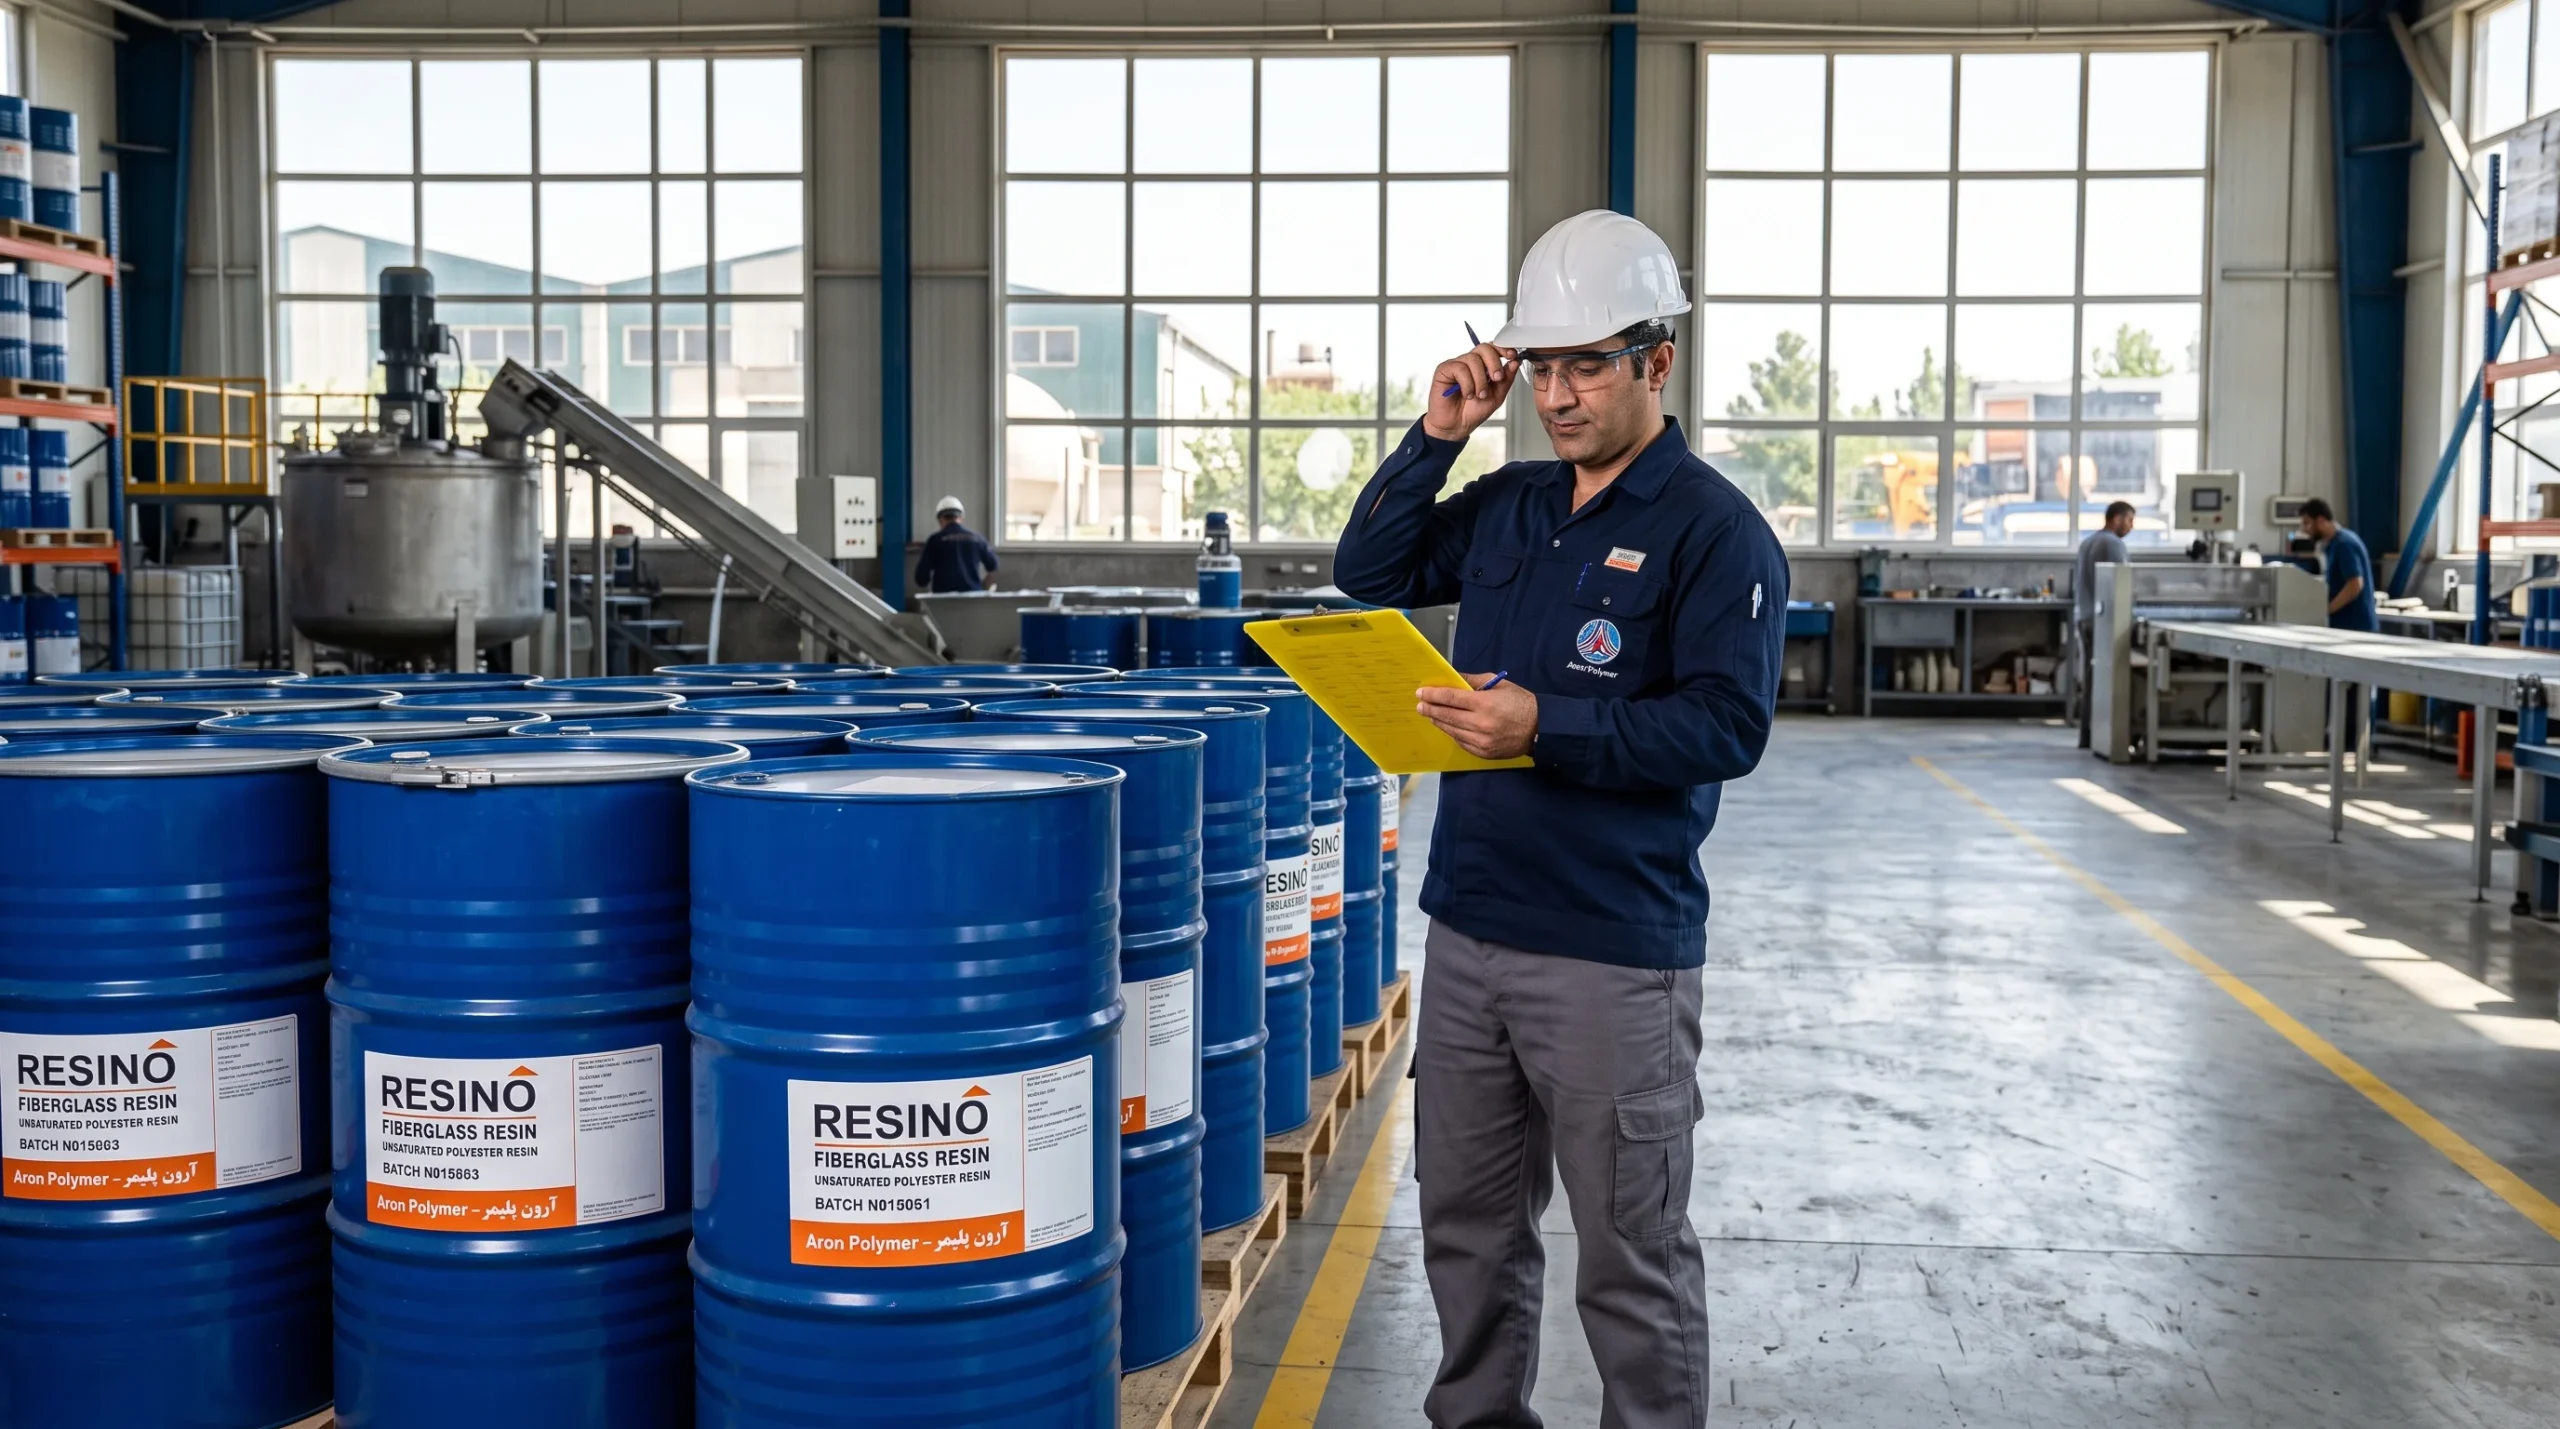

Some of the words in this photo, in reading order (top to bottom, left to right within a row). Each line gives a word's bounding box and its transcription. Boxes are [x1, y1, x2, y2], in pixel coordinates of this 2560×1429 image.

[1311, 834, 1340, 856] SINO
[1266, 868, 1308, 893] ESINO
[19, 1096, 117, 1112] FIBERGLASS
[124, 1094, 177, 1111] RESIN
[19, 1118, 83, 1129] UNSATURATED
[85, 1117, 143, 1129] POLYESTER
[147, 1116, 179, 1126] RESIN
[382, 1119, 478, 1140] FIBERGLASS
[484, 1124, 537, 1139] RESIN
[19, 1138, 59, 1151] BATCH
[382, 1142, 443, 1156] UNSATURATED
[446, 1147, 503, 1157] POLYESTER
[507, 1147, 538, 1157] RESIN
[814, 1151, 928, 1169] FIBERGLASS
[935, 1146, 990, 1166] RESIN
[13, 1170, 45, 1185] Aron
[48, 1172, 109, 1189] Polymer
[122, 1168, 157, 1188] پلیمر
[162, 1161, 198, 1184] آرون
[383, 1162, 420, 1177] BATCH
[815, 1175, 891, 1187] UNSATURATED
[894, 1174, 956, 1186] POLYESTER
[959, 1170, 990, 1182] RESIN
[377, 1195, 405, 1210] Aron
[409, 1199, 468, 1216] Polymer
[482, 1201, 516, 1221] پلیمر
[521, 1196, 558, 1219] آرون
[815, 1198, 862, 1211] BATCH
[806, 1234, 844, 1249] Aron
[849, 1235, 919, 1254] Polymer
[934, 1229, 969, 1252] پلیمر
[974, 1222, 1009, 1246] آرون
